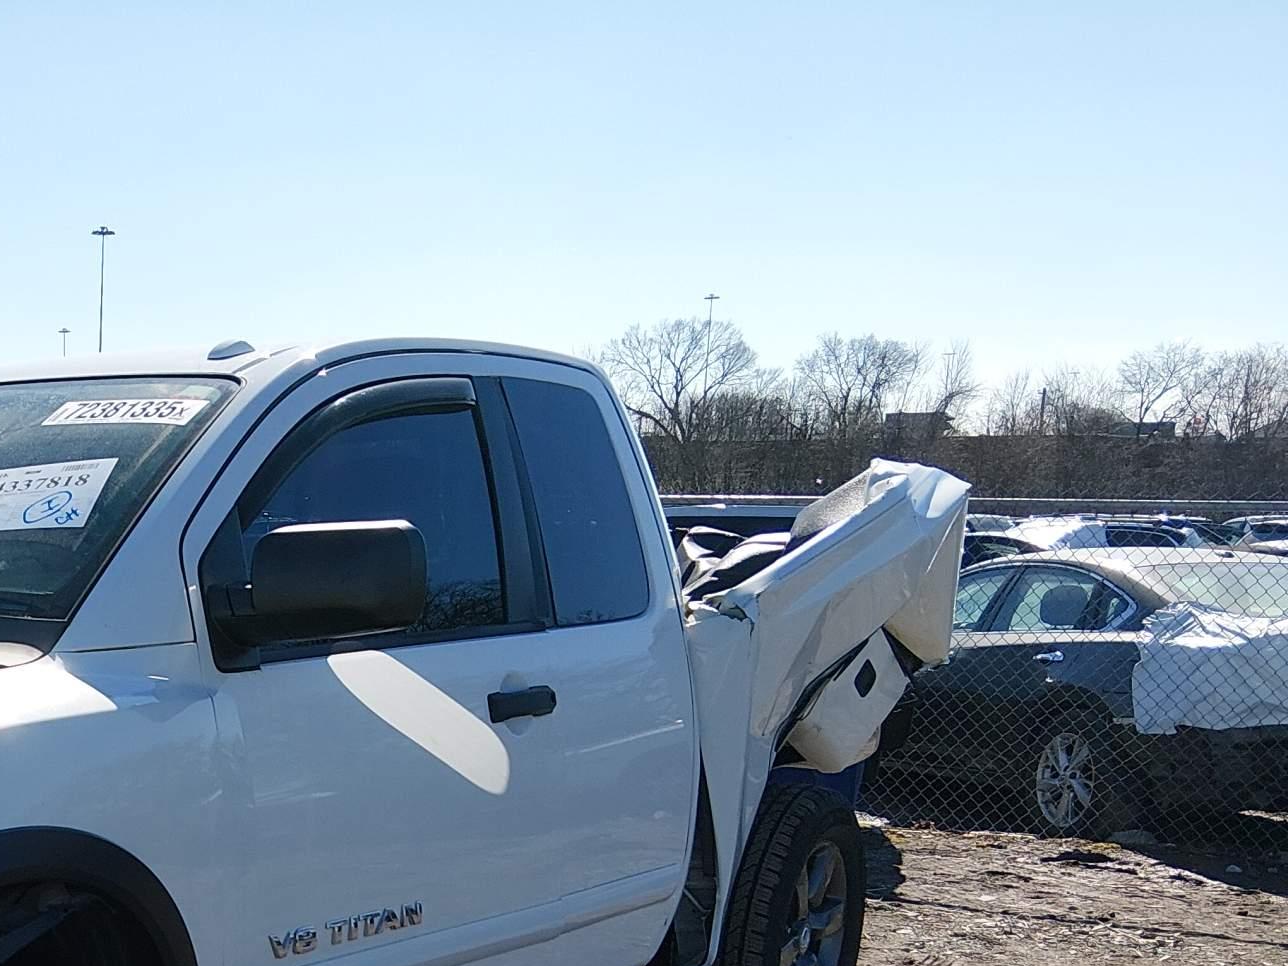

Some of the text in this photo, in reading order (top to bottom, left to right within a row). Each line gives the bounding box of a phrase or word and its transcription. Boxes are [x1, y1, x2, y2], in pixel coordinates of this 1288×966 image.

[64, 401, 184, 419] 72381335
[268, 900, 424, 960] V8 TITAN
